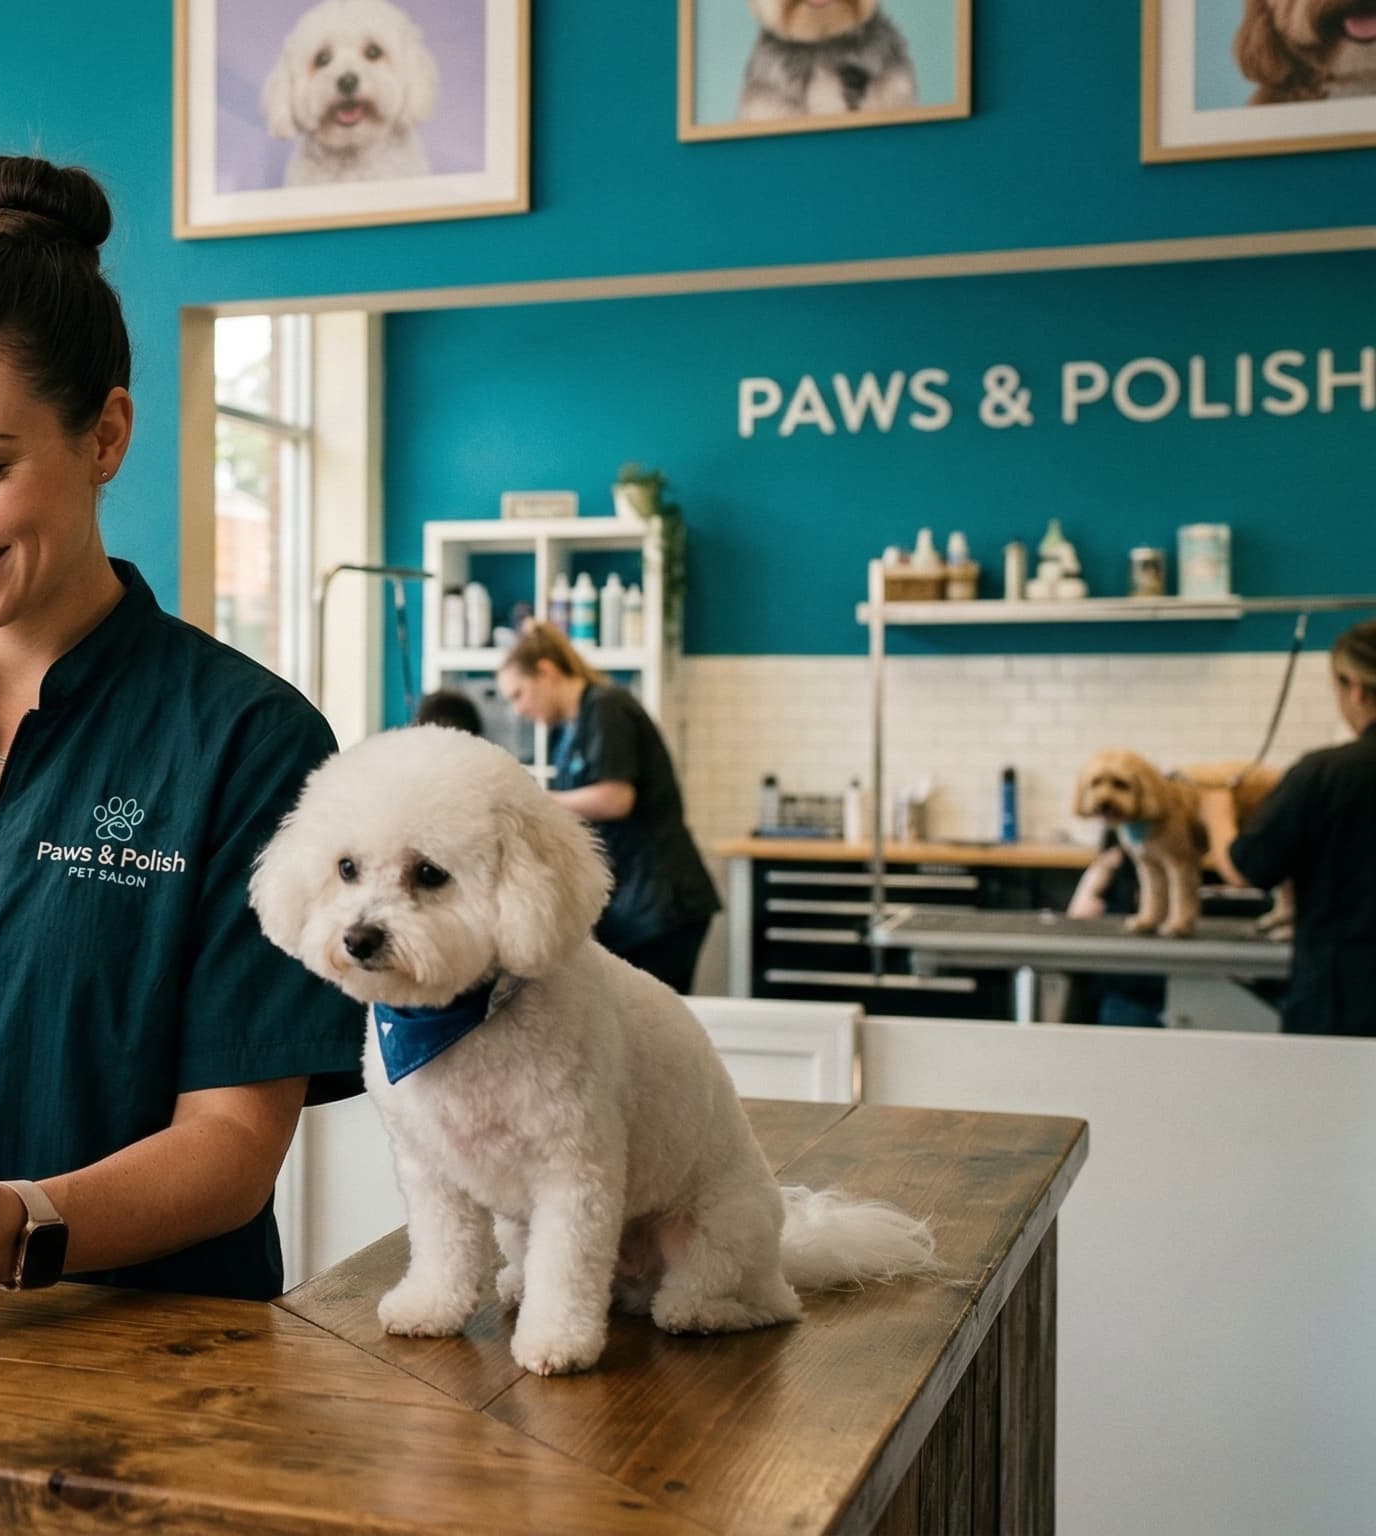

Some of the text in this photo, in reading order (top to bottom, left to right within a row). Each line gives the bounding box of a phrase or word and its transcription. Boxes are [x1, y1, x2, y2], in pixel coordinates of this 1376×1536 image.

[737, 346, 1376, 439] PAWS & POLISH
[37, 841, 187, 874] Paws & Polish
[67, 866, 147, 889] PET SALON
